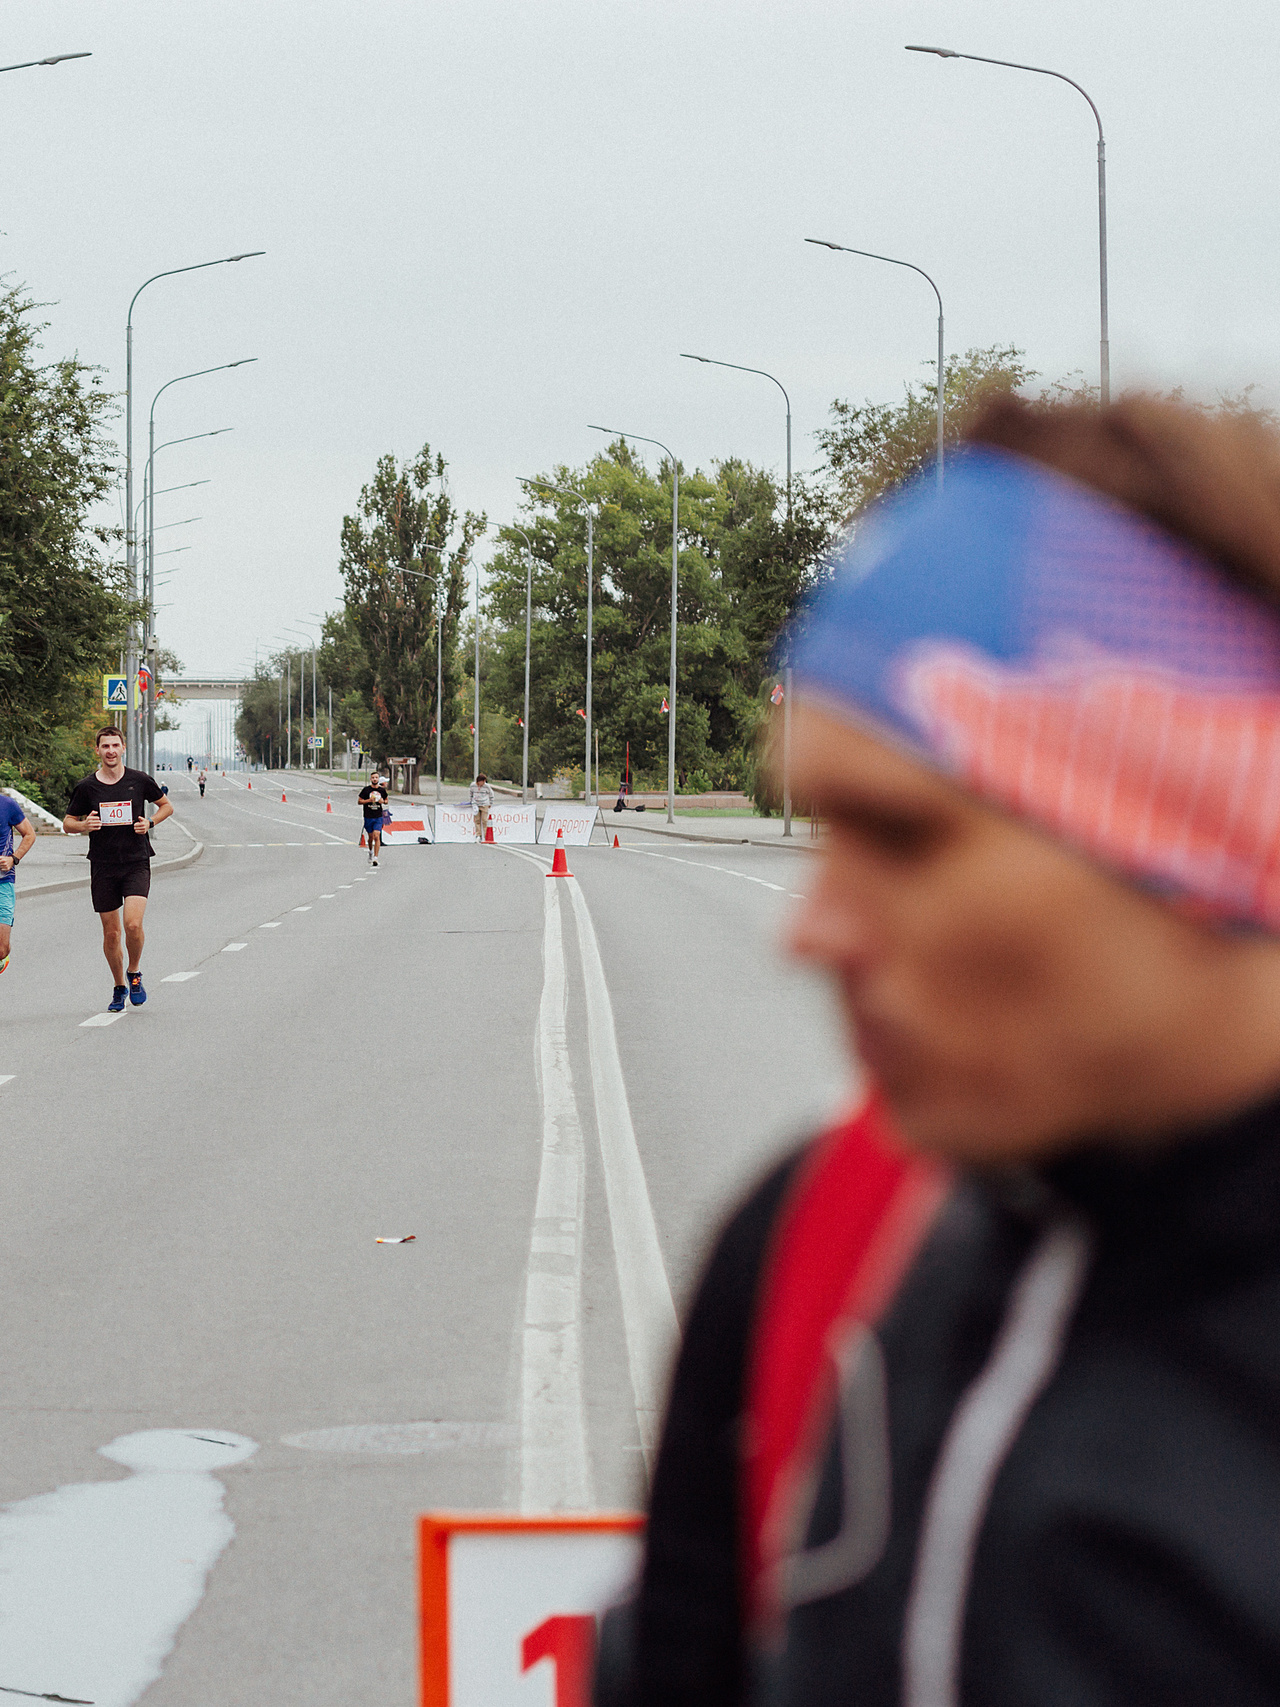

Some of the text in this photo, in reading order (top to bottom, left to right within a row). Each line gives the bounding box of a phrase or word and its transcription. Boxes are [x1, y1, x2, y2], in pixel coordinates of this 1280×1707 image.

[109, 808, 123, 819] 40
[442, 812, 529, 824] ПОЛУРАФОН
[548, 818, 591, 834] ПОВОРОТ
